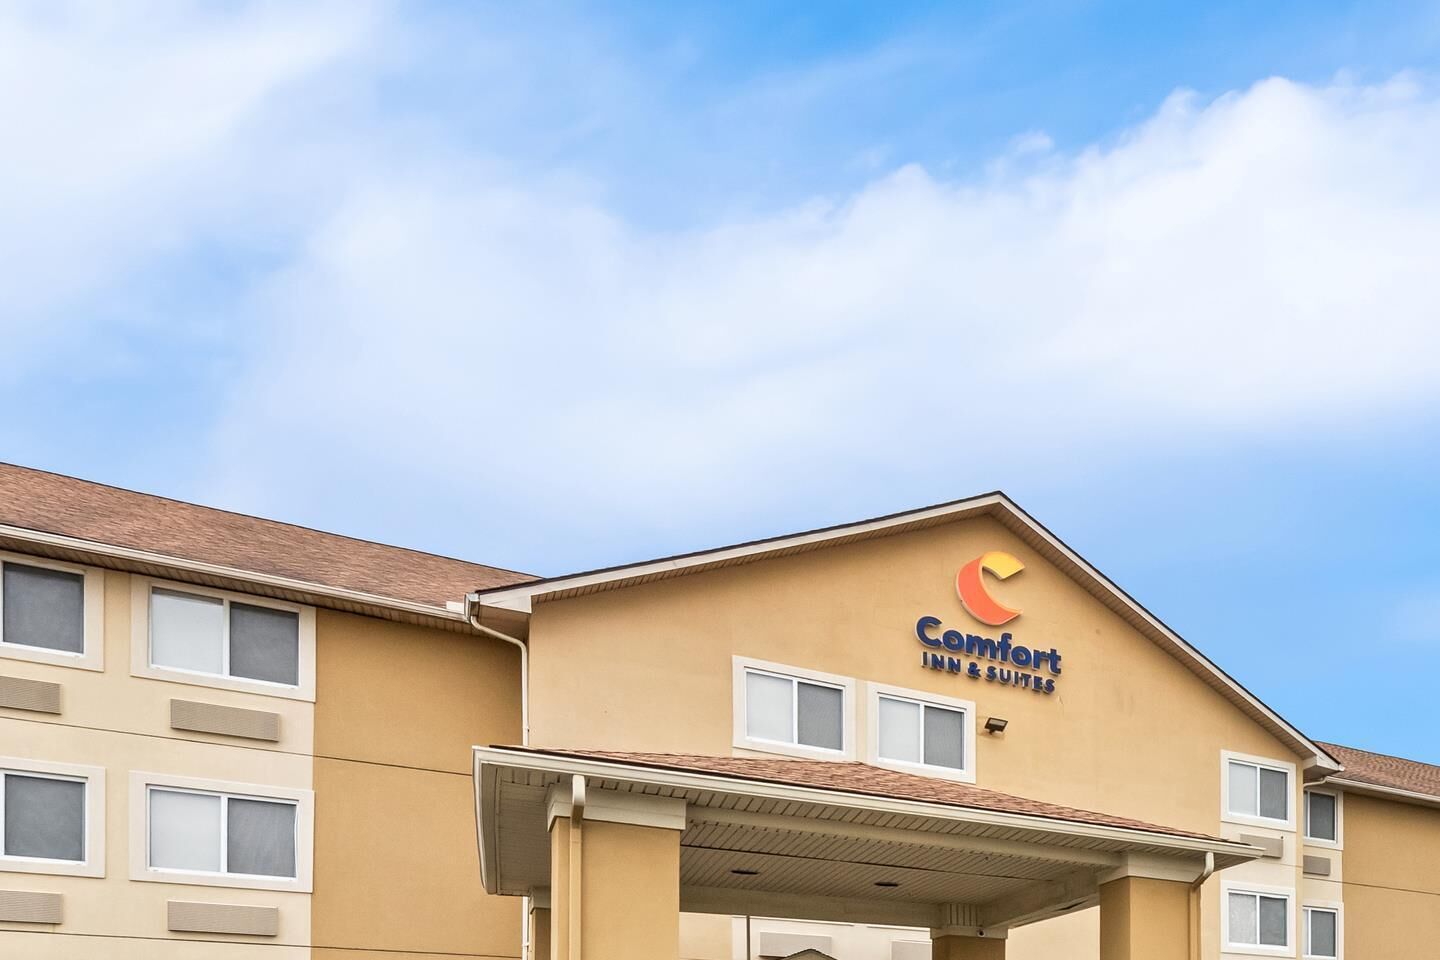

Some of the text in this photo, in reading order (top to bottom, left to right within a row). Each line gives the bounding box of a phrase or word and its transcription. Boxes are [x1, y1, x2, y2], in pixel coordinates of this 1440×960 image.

[915, 616, 1062, 675] Comfort
[921, 652, 1055, 694] INN & SUITES
